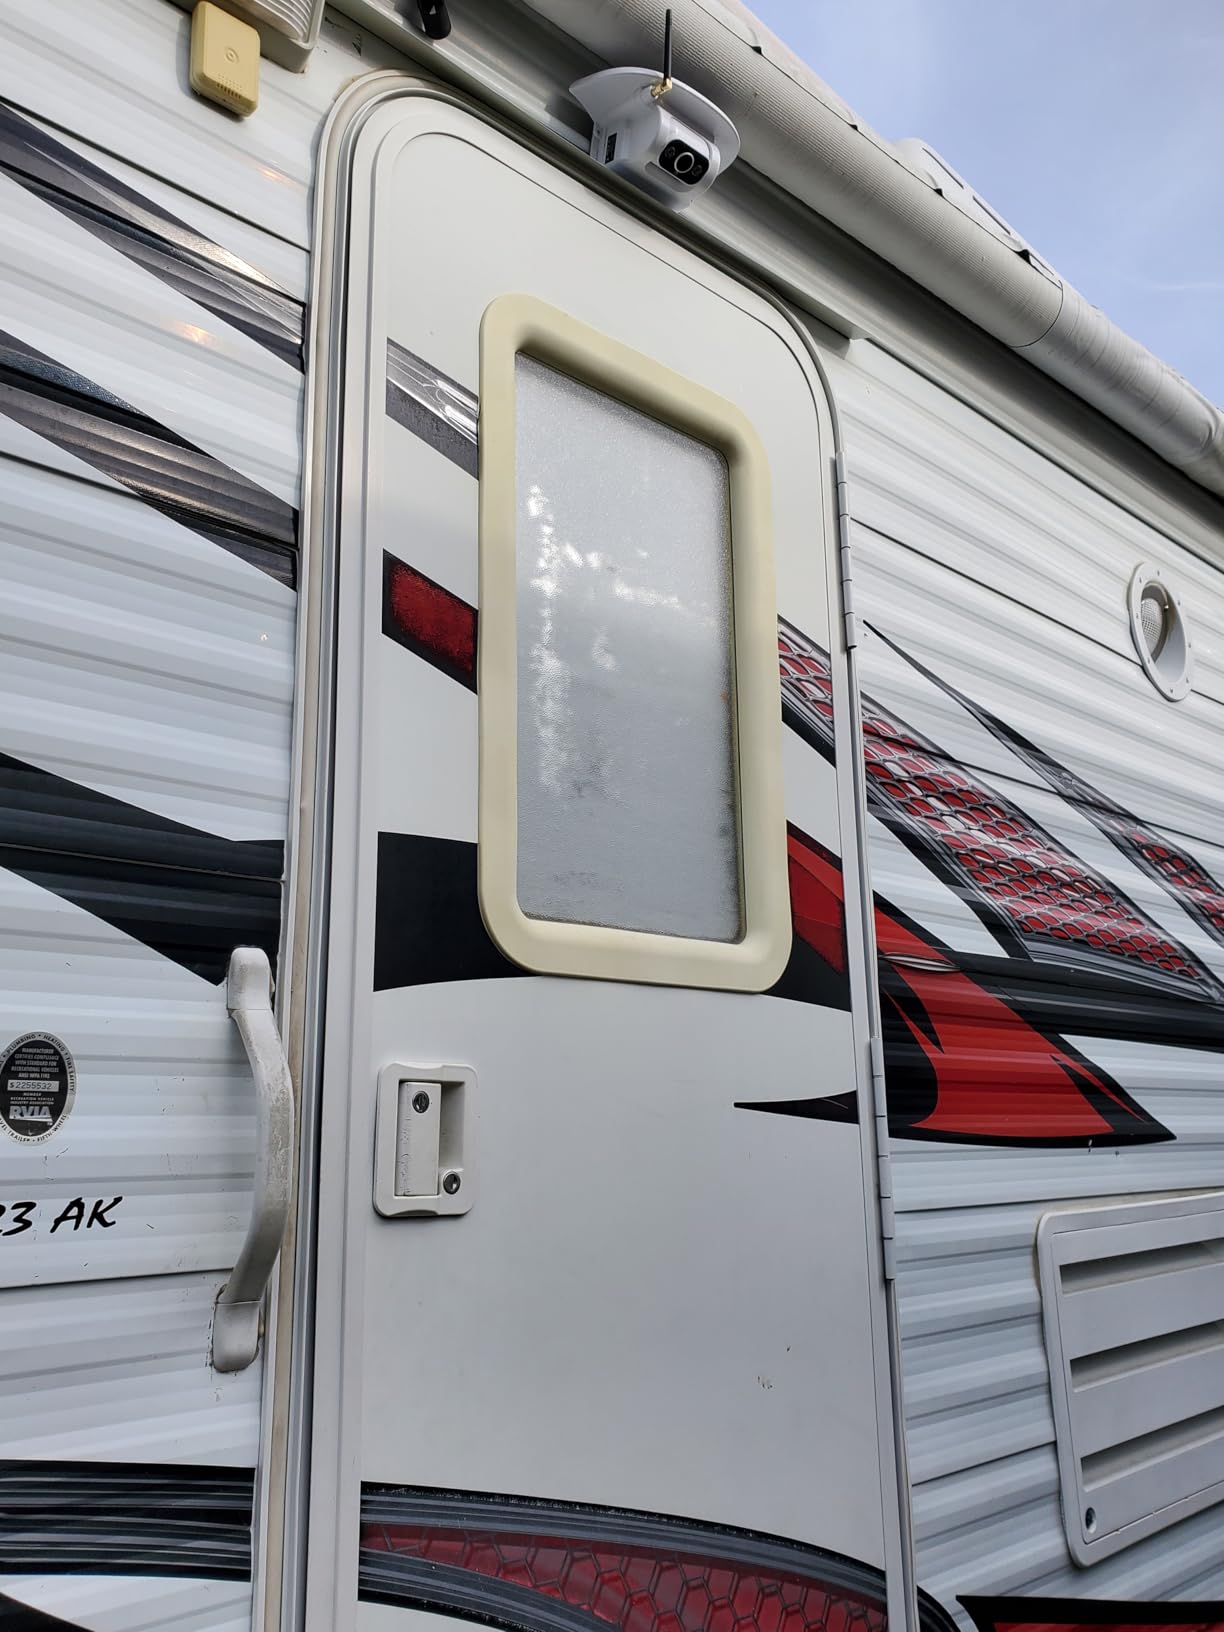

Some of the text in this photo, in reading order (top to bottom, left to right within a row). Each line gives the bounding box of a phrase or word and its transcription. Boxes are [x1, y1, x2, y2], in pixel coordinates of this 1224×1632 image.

[6, 1034, 36, 1054] PLUMBING
[43, 1034, 66, 1052] HEATING
[9, 1106, 51, 1117] RVIA
[0, 1195, 123, 1237] 3 AK
